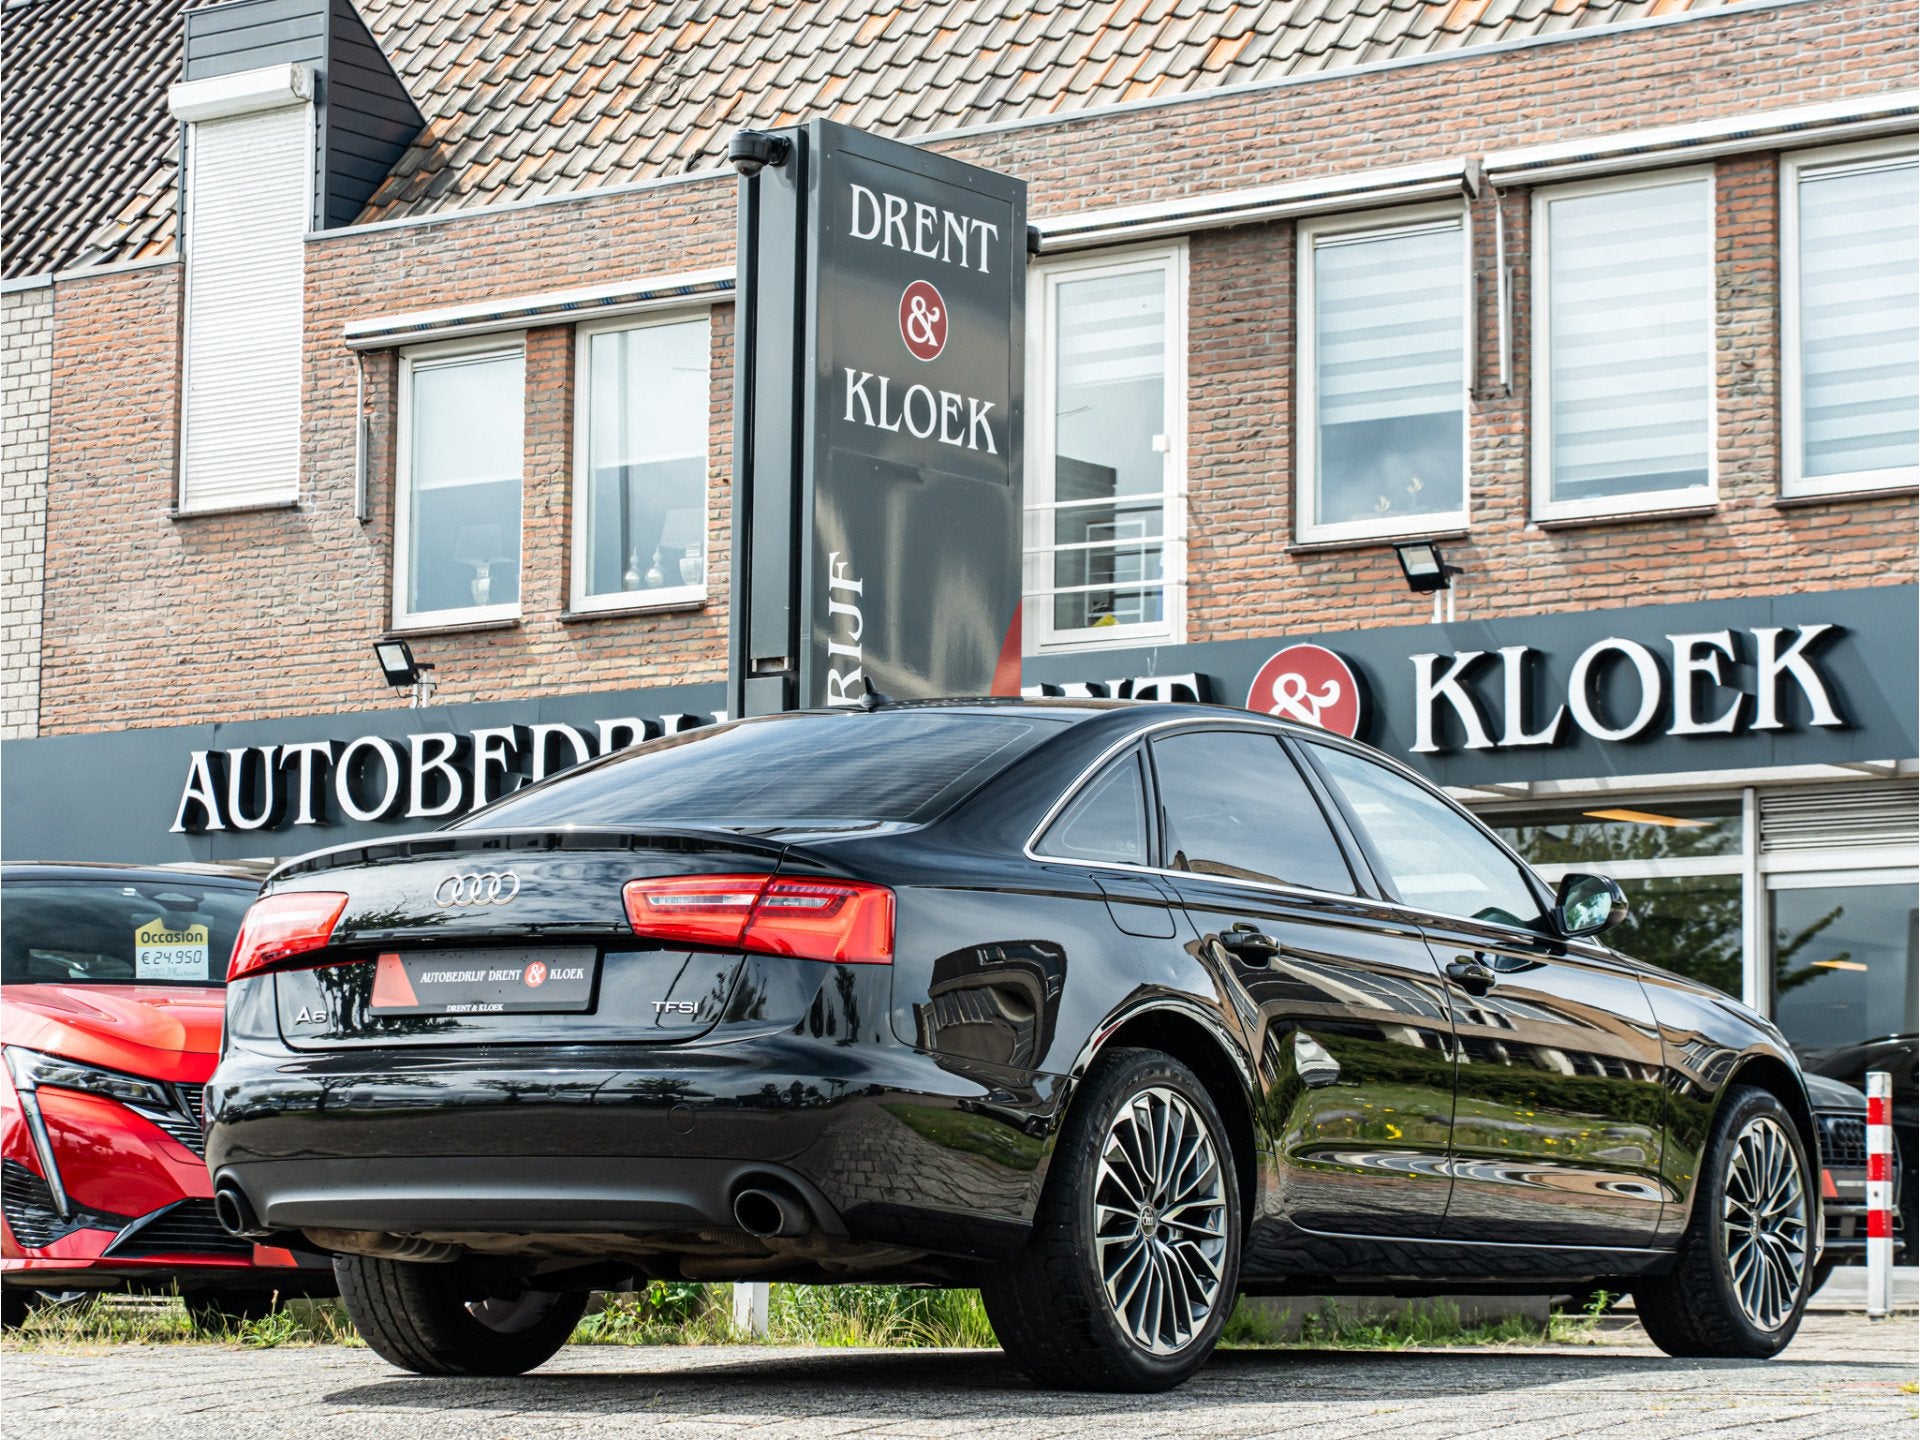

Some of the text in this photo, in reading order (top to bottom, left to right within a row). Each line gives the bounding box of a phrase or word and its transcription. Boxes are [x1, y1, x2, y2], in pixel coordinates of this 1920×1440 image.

[849, 183, 999, 274] DRENT
[907, 295, 941, 347] &
[843, 367, 998, 455] KLOEK
[1409, 623, 1843, 752] KLOEK
[141, 931, 203, 944] Occasion
[153, 950, 203, 965] 24.950
[420, 964, 584, 985] AUTOBEDRIJF DRENT & KLOEK
[295, 1006, 328, 1025] A6
[446, 1004, 472, 1012] DRENT
[478, 1003, 504, 1011] KLOEK
[651, 1001, 699, 1014] TFSI
